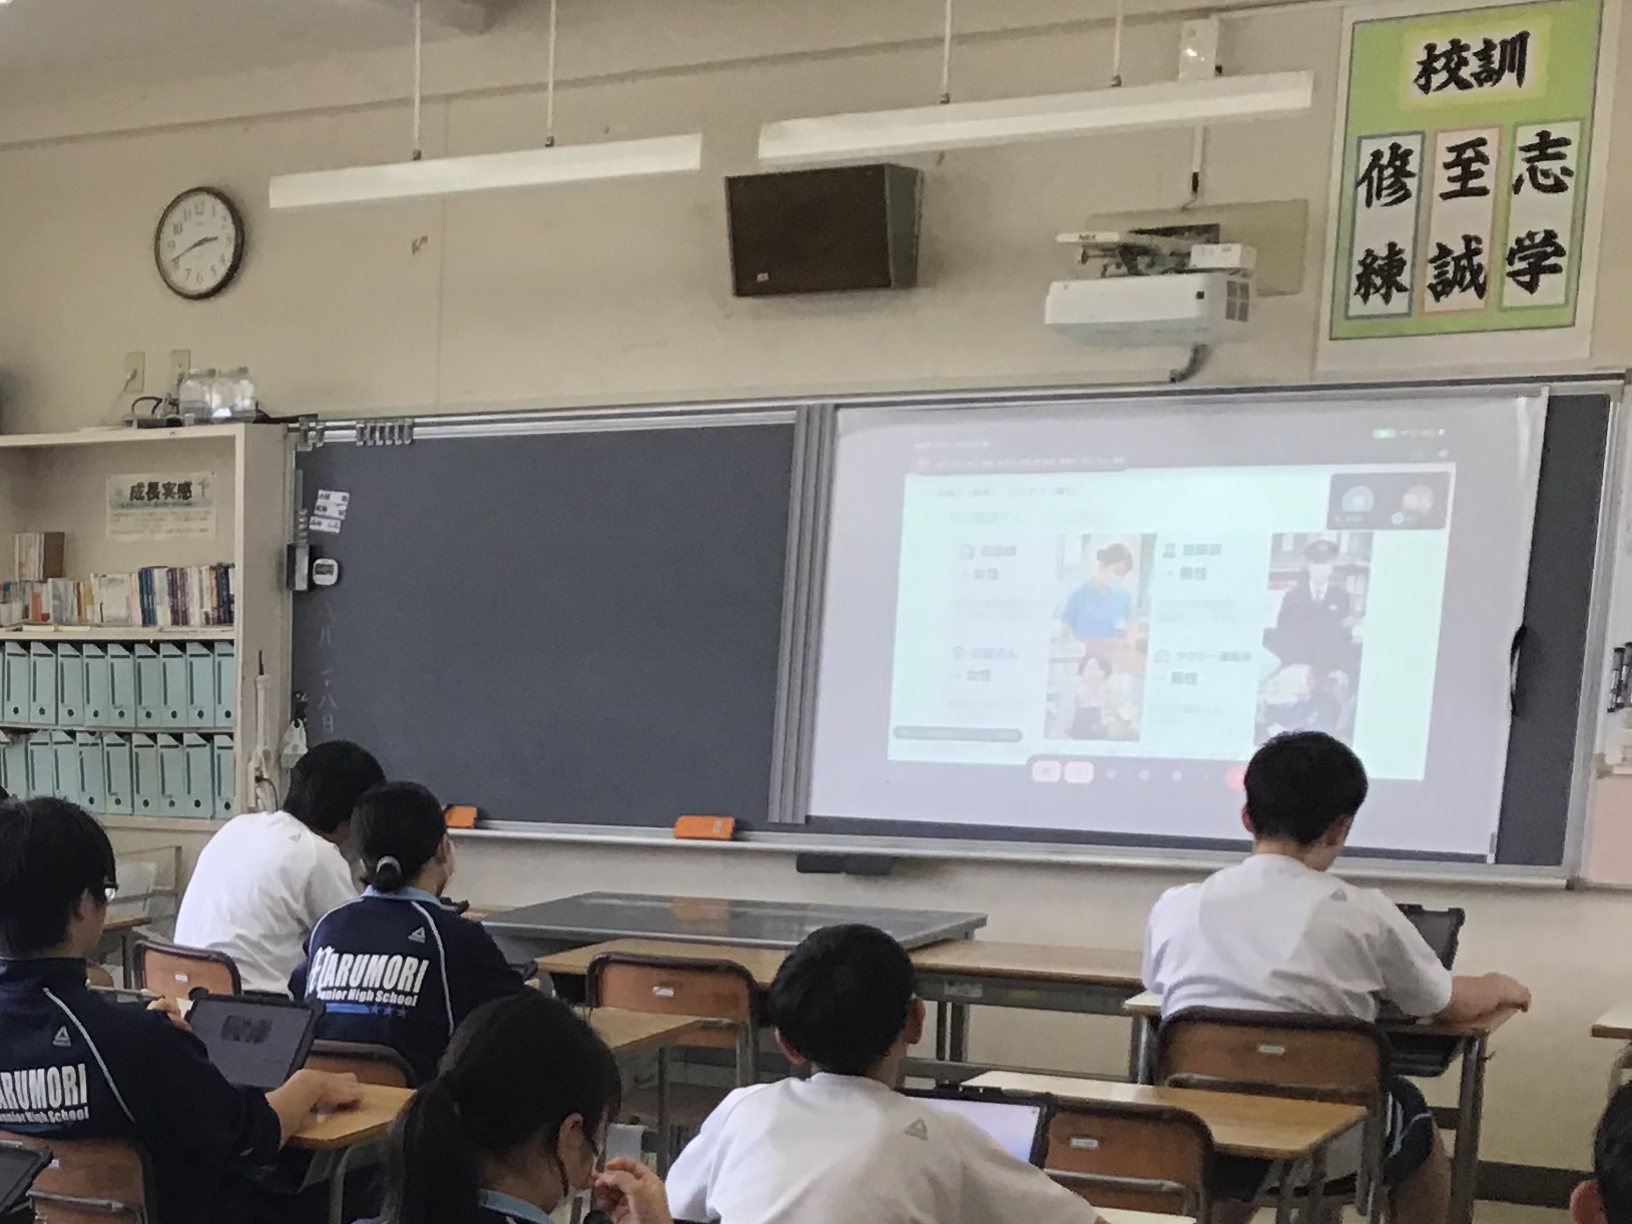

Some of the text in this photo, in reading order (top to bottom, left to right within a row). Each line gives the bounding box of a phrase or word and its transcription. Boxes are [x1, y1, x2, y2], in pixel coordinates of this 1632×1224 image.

[1414, 31, 1530, 94] 校訓
[1356, 142, 1417, 305] 修練
[1426, 136, 1490, 303] 至誠
[1505, 129, 1575, 295] 志学
[375, 990, 418, 1007] School
